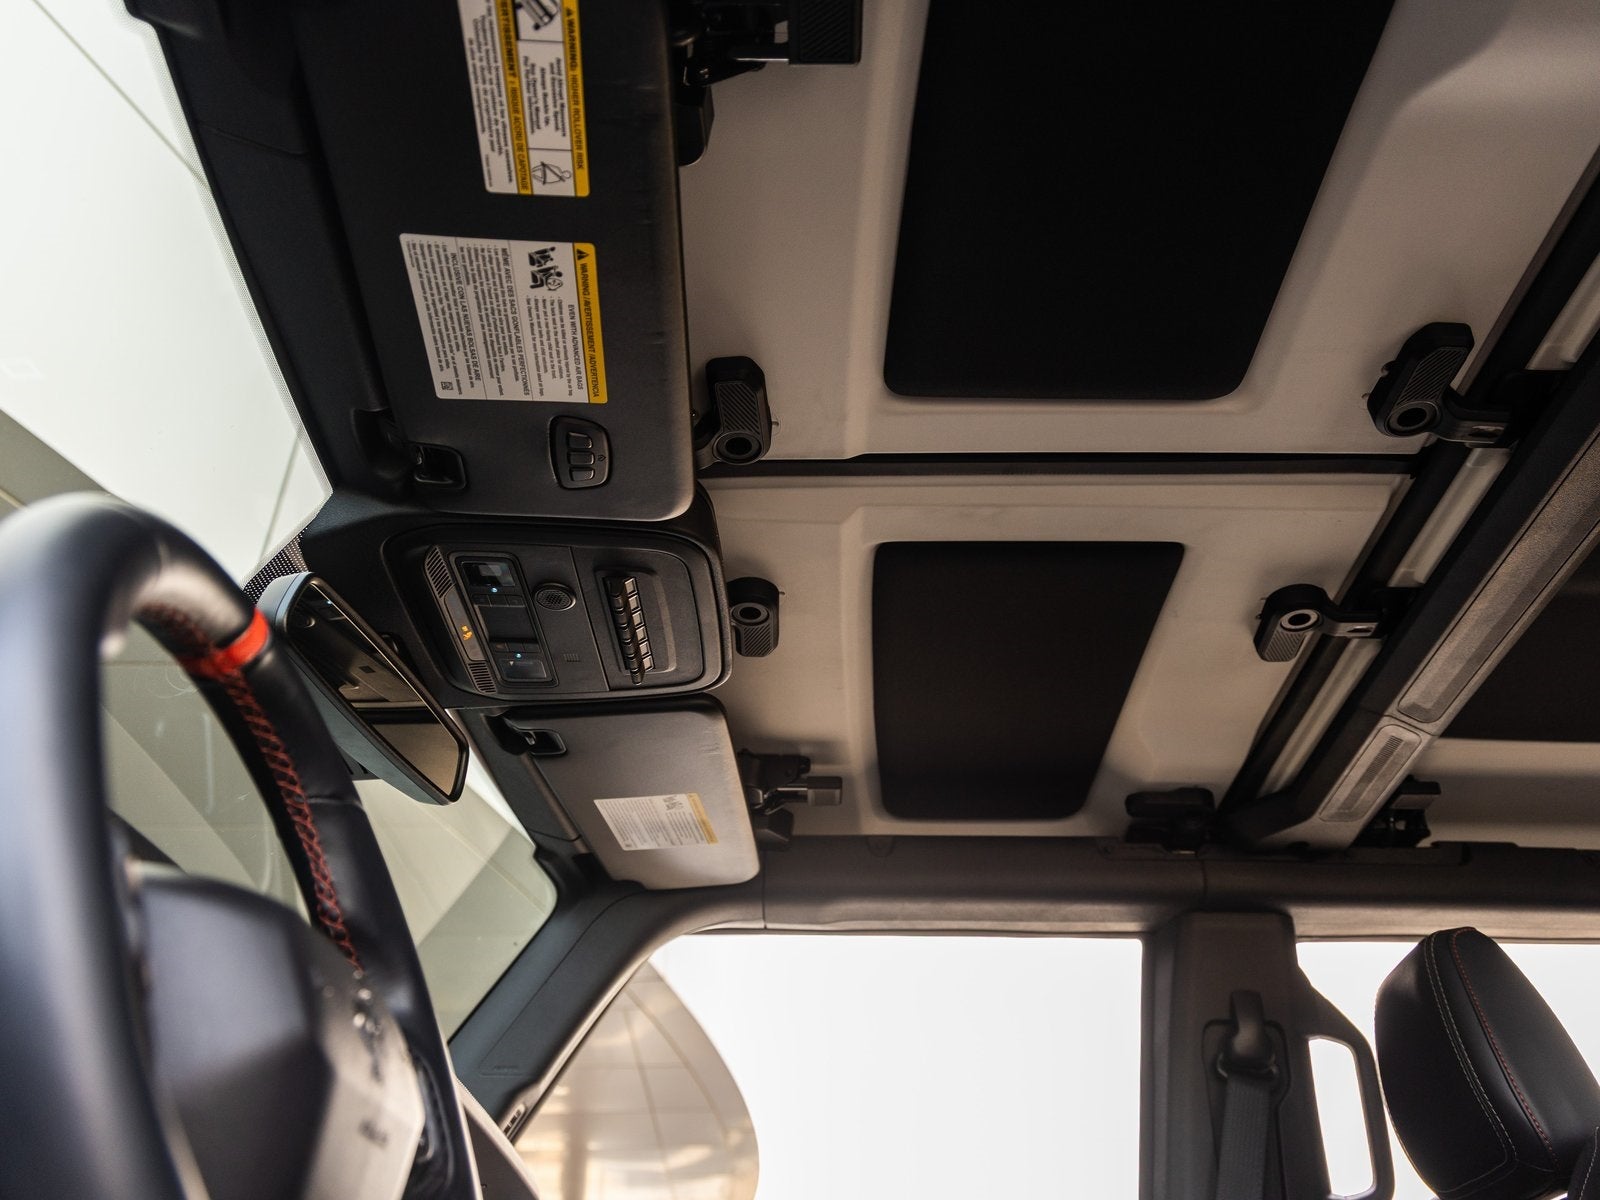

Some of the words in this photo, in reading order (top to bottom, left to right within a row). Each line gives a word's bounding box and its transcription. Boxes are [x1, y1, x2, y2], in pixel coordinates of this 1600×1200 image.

[500, 0, 516, 76] ERTISSEMENT
[566, 18, 577, 71] WARNING:
[510, 86, 520, 114] RISQUE
[570, 74, 579, 105] HIGHER
[513, 116, 523, 140] ACCRU
[572, 108, 582, 150] ROLLOVER
[516, 142, 524, 152] DE
[518, 153, 528, 190] CAPOTAGE
[450, 252, 462, 284] INCLUSIVE
[500, 247, 510, 266] MÊME
[503, 267, 513, 284] AVEC
[580, 262, 590, 295] WARNING
[456, 285, 465, 299] CON
[506, 285, 515, 297] DES
[459, 300, 468, 312] LAS
[508, 298, 517, 314] SACS
[568, 304, 576, 319] EVEN
[462, 313, 472, 336] NUEVAS
[511, 315, 523, 353] GONFLABLES
[466, 337, 477, 359] BOLSAS
[571, 336, 580, 365] ADVANCED
[472, 368, 481, 381] AIRE
